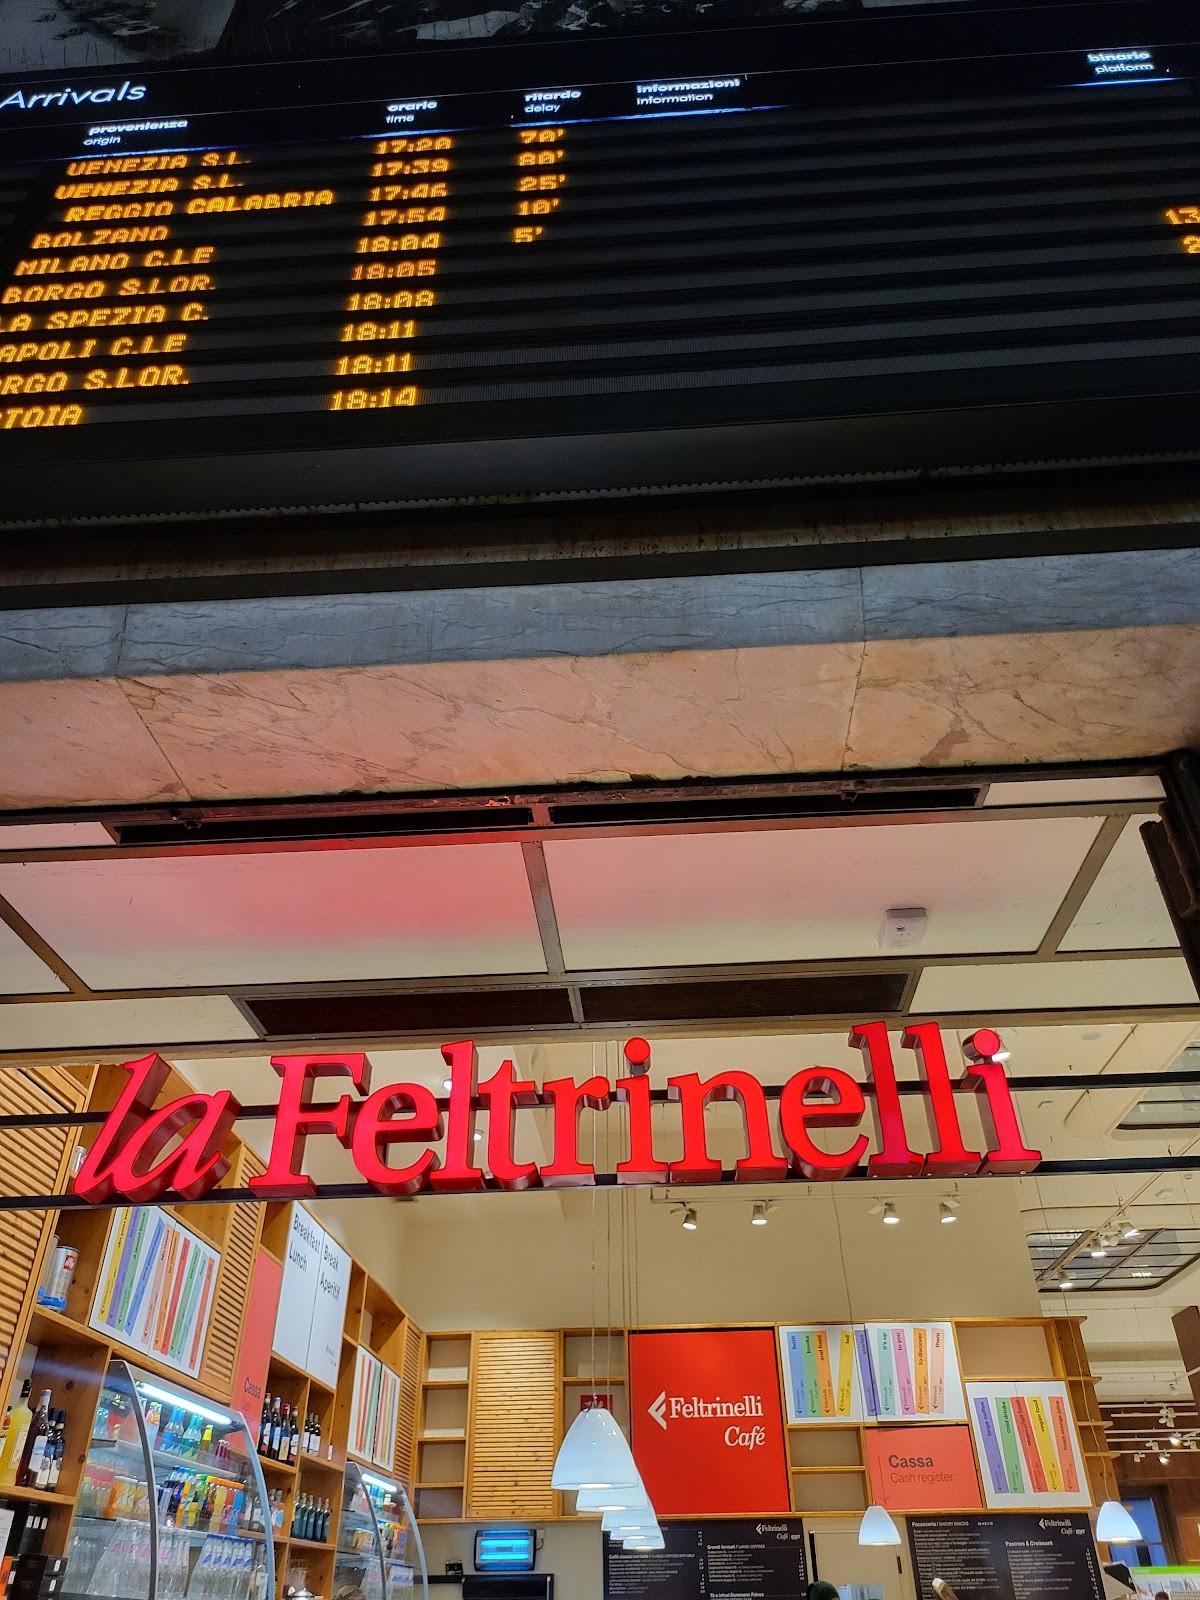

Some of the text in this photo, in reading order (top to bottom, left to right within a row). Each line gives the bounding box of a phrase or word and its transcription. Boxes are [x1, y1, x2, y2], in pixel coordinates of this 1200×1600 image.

[1087, 51, 1151, 62] binario
[1094, 63, 1155, 75] platform
[0, 81, 147, 109] Arrivals
[386, 100, 438, 113] orario
[524, 90, 582, 102] ritardo
[636, 92, 714, 106] information
[385, 114, 415, 124] time
[524, 103, 561, 114] delay
[88, 120, 188, 136] provenienza
[83, 136, 121, 146] origin
[66, 154, 188, 176] VENEZIA
[55, 177, 179, 199] VENEZIA
[370, 158, 449, 177] 17:39
[63, 201, 174, 222] REGGIO
[187, 189, 334, 214] CALABRIA
[368, 182, 448, 201] 17:46
[30, 225, 170, 249] BOLZANO
[363, 206, 447, 226] 17:54
[14, 252, 129, 276] MILANO
[356, 232, 441, 253] 18:04
[2, 280, 105, 304] BORGO
[352, 259, 437, 281] 18:05
[0, 313, 32, 333] A
[47, 304, 166, 330] SPEZIA
[347, 289, 435, 311] 18:08
[341, 320, 415, 342] 18:11
[0, 371, 67, 395] RGO
[334, 353, 412, 375] 18:11
[0, 386, 417, 429] TOIA 18:14
[73, 1021, 1041, 1203] la Feltrinelli
[293, 1214, 339, 1273] Breakfast Break
[289, 1242, 308, 1273] Lunch
[244, 1376, 261, 1399] Cassa
[668, 1395, 765, 1419] Feltrinelli
[1033, 1399, 1045, 1432] vegan food
[724, 1425, 766, 1450] Café
[888, 1454, 934, 1468] Cassa
[890, 1471, 953, 1485] Cash register
[761, 1523, 788, 1532] Feltrinelli
[1044, 1518, 1072, 1527] Feltrinelli
